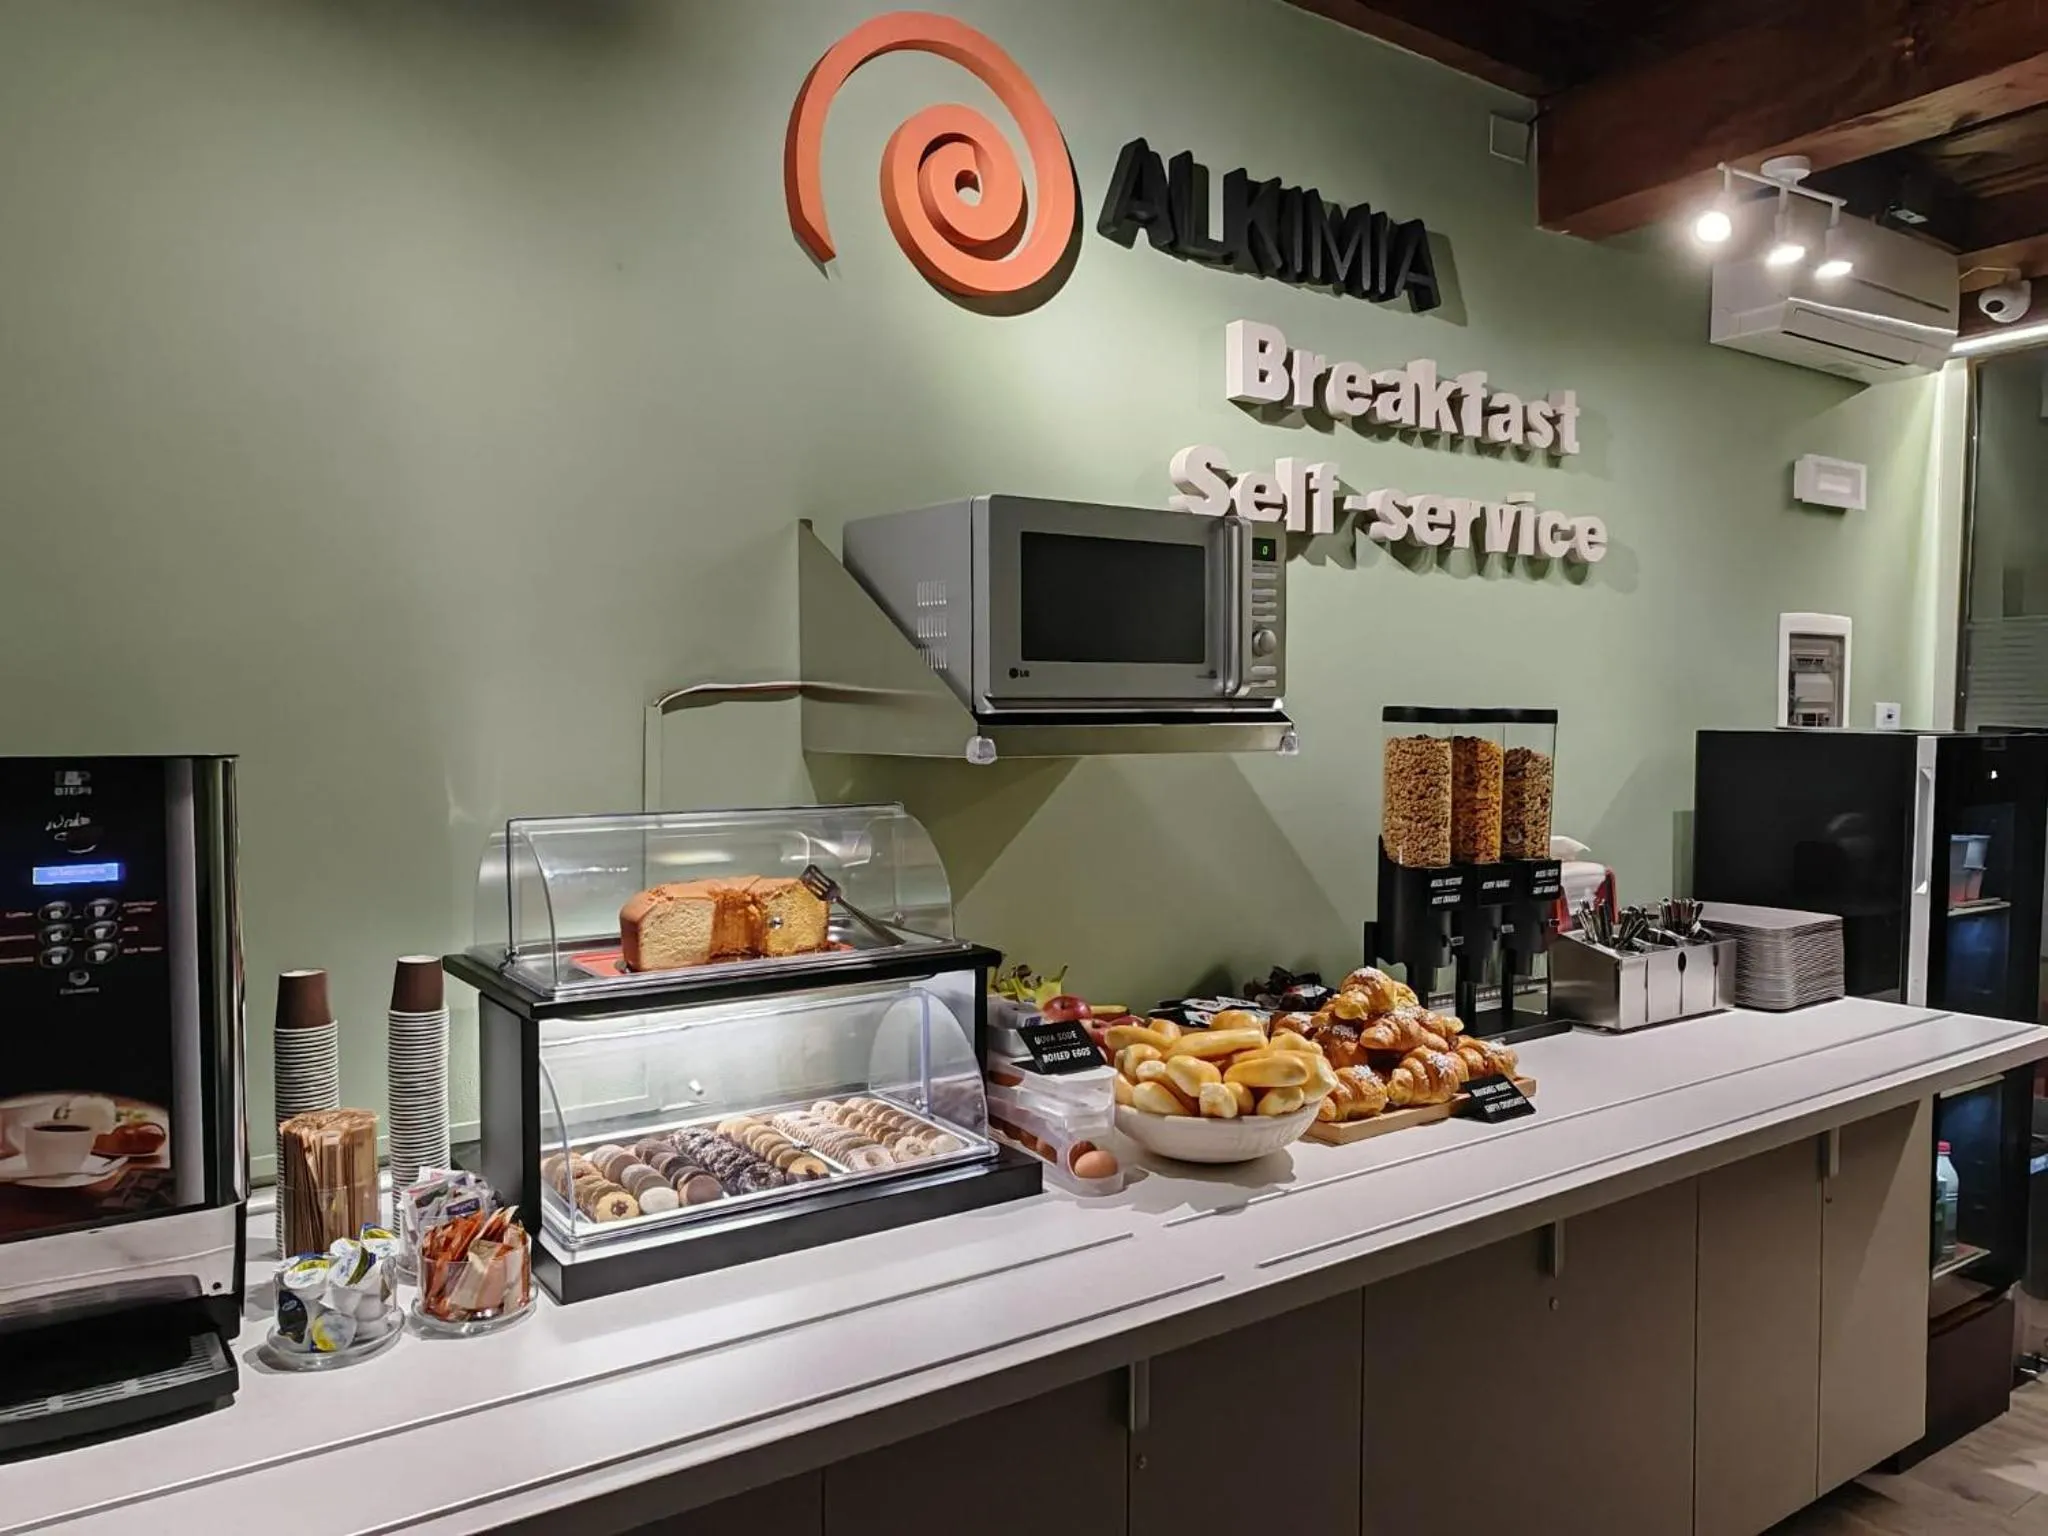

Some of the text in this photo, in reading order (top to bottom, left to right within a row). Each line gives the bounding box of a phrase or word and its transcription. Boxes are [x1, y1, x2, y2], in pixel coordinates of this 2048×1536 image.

[1097, 137, 1441, 313] ALKIMIA
[1225, 318, 1580, 455] Breakfast
[1168, 444, 1608, 563] Self-service
[1042, 1046, 1092, 1064] BOILED EGGS
